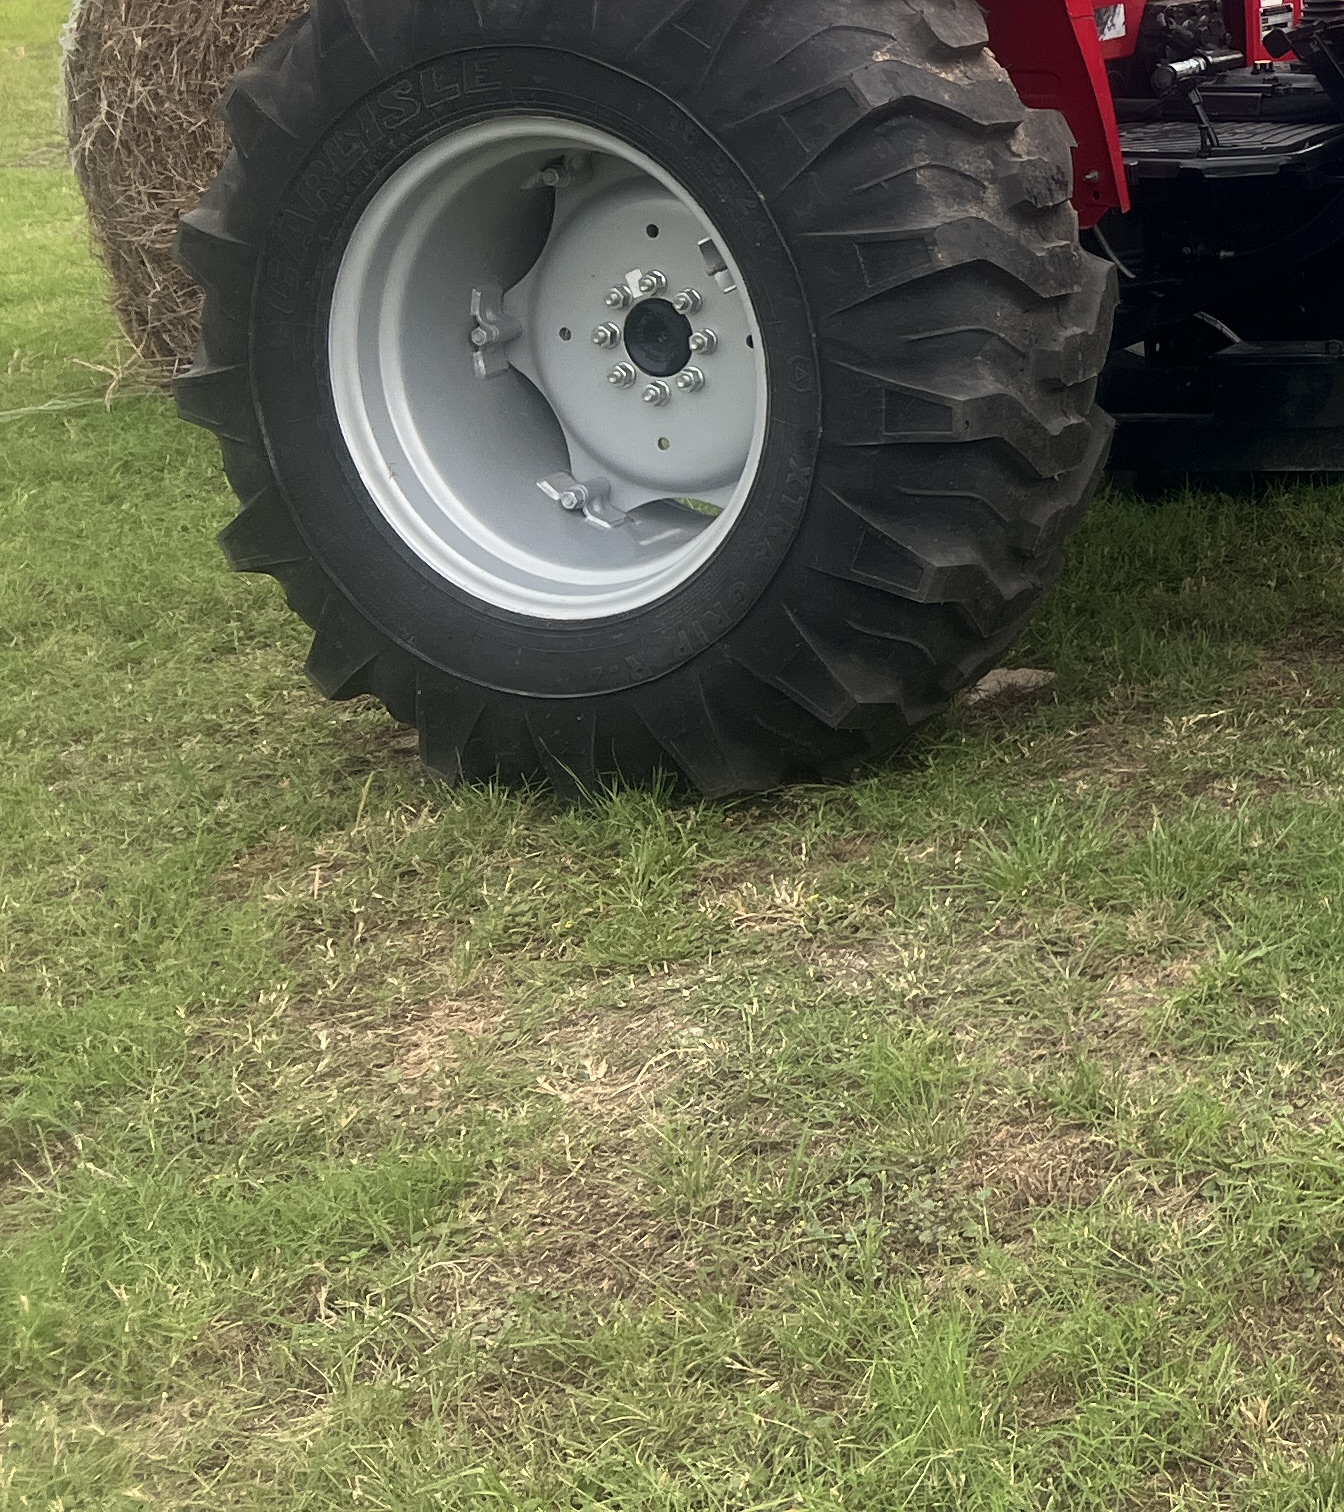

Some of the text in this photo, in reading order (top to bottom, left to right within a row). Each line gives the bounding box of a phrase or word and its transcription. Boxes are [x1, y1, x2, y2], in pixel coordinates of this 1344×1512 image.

[266, 53, 502, 314] CARLISLE
[755, 455, 812, 560] XTRA
[669, 579, 749, 660] GRIP
